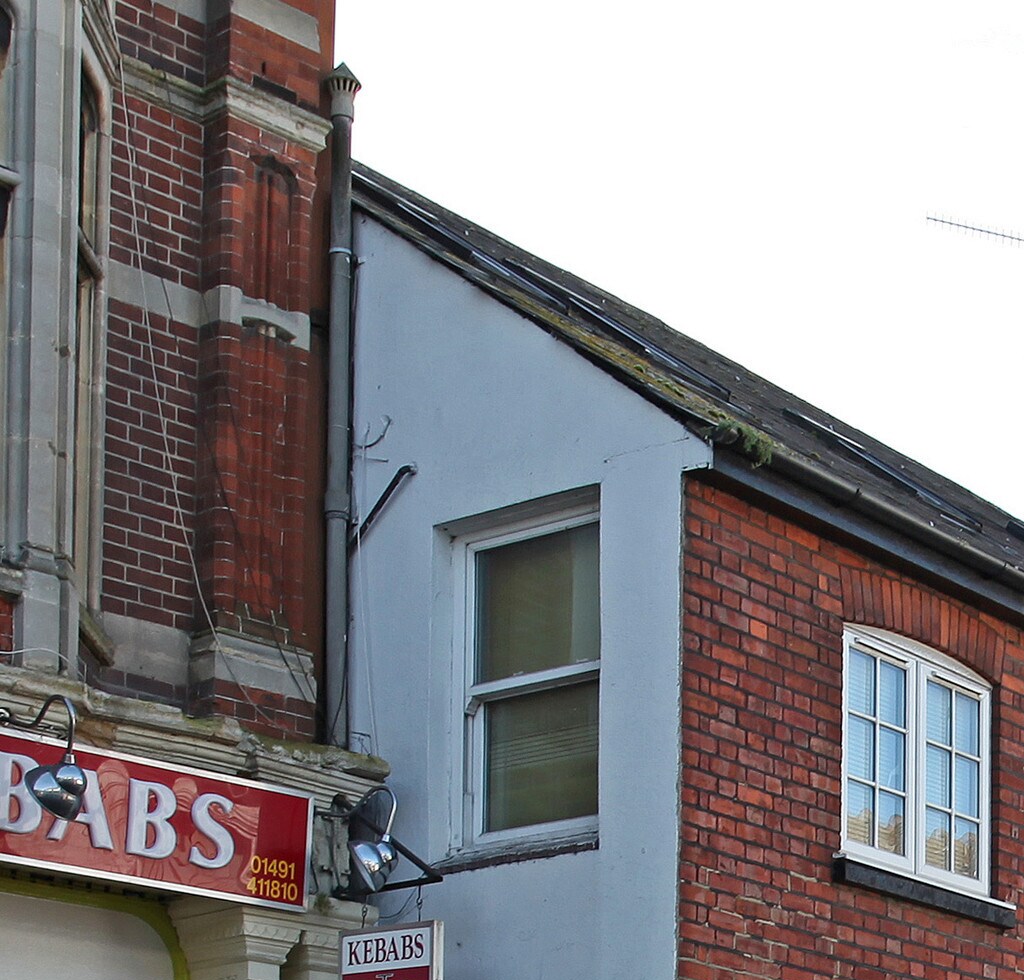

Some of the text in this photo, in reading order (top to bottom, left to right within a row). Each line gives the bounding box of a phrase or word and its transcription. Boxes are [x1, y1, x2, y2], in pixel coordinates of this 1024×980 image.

[250, 855, 295, 880] 01491
[246, 878, 298, 901] 411810
[347, 933, 424, 967] KEBABS
